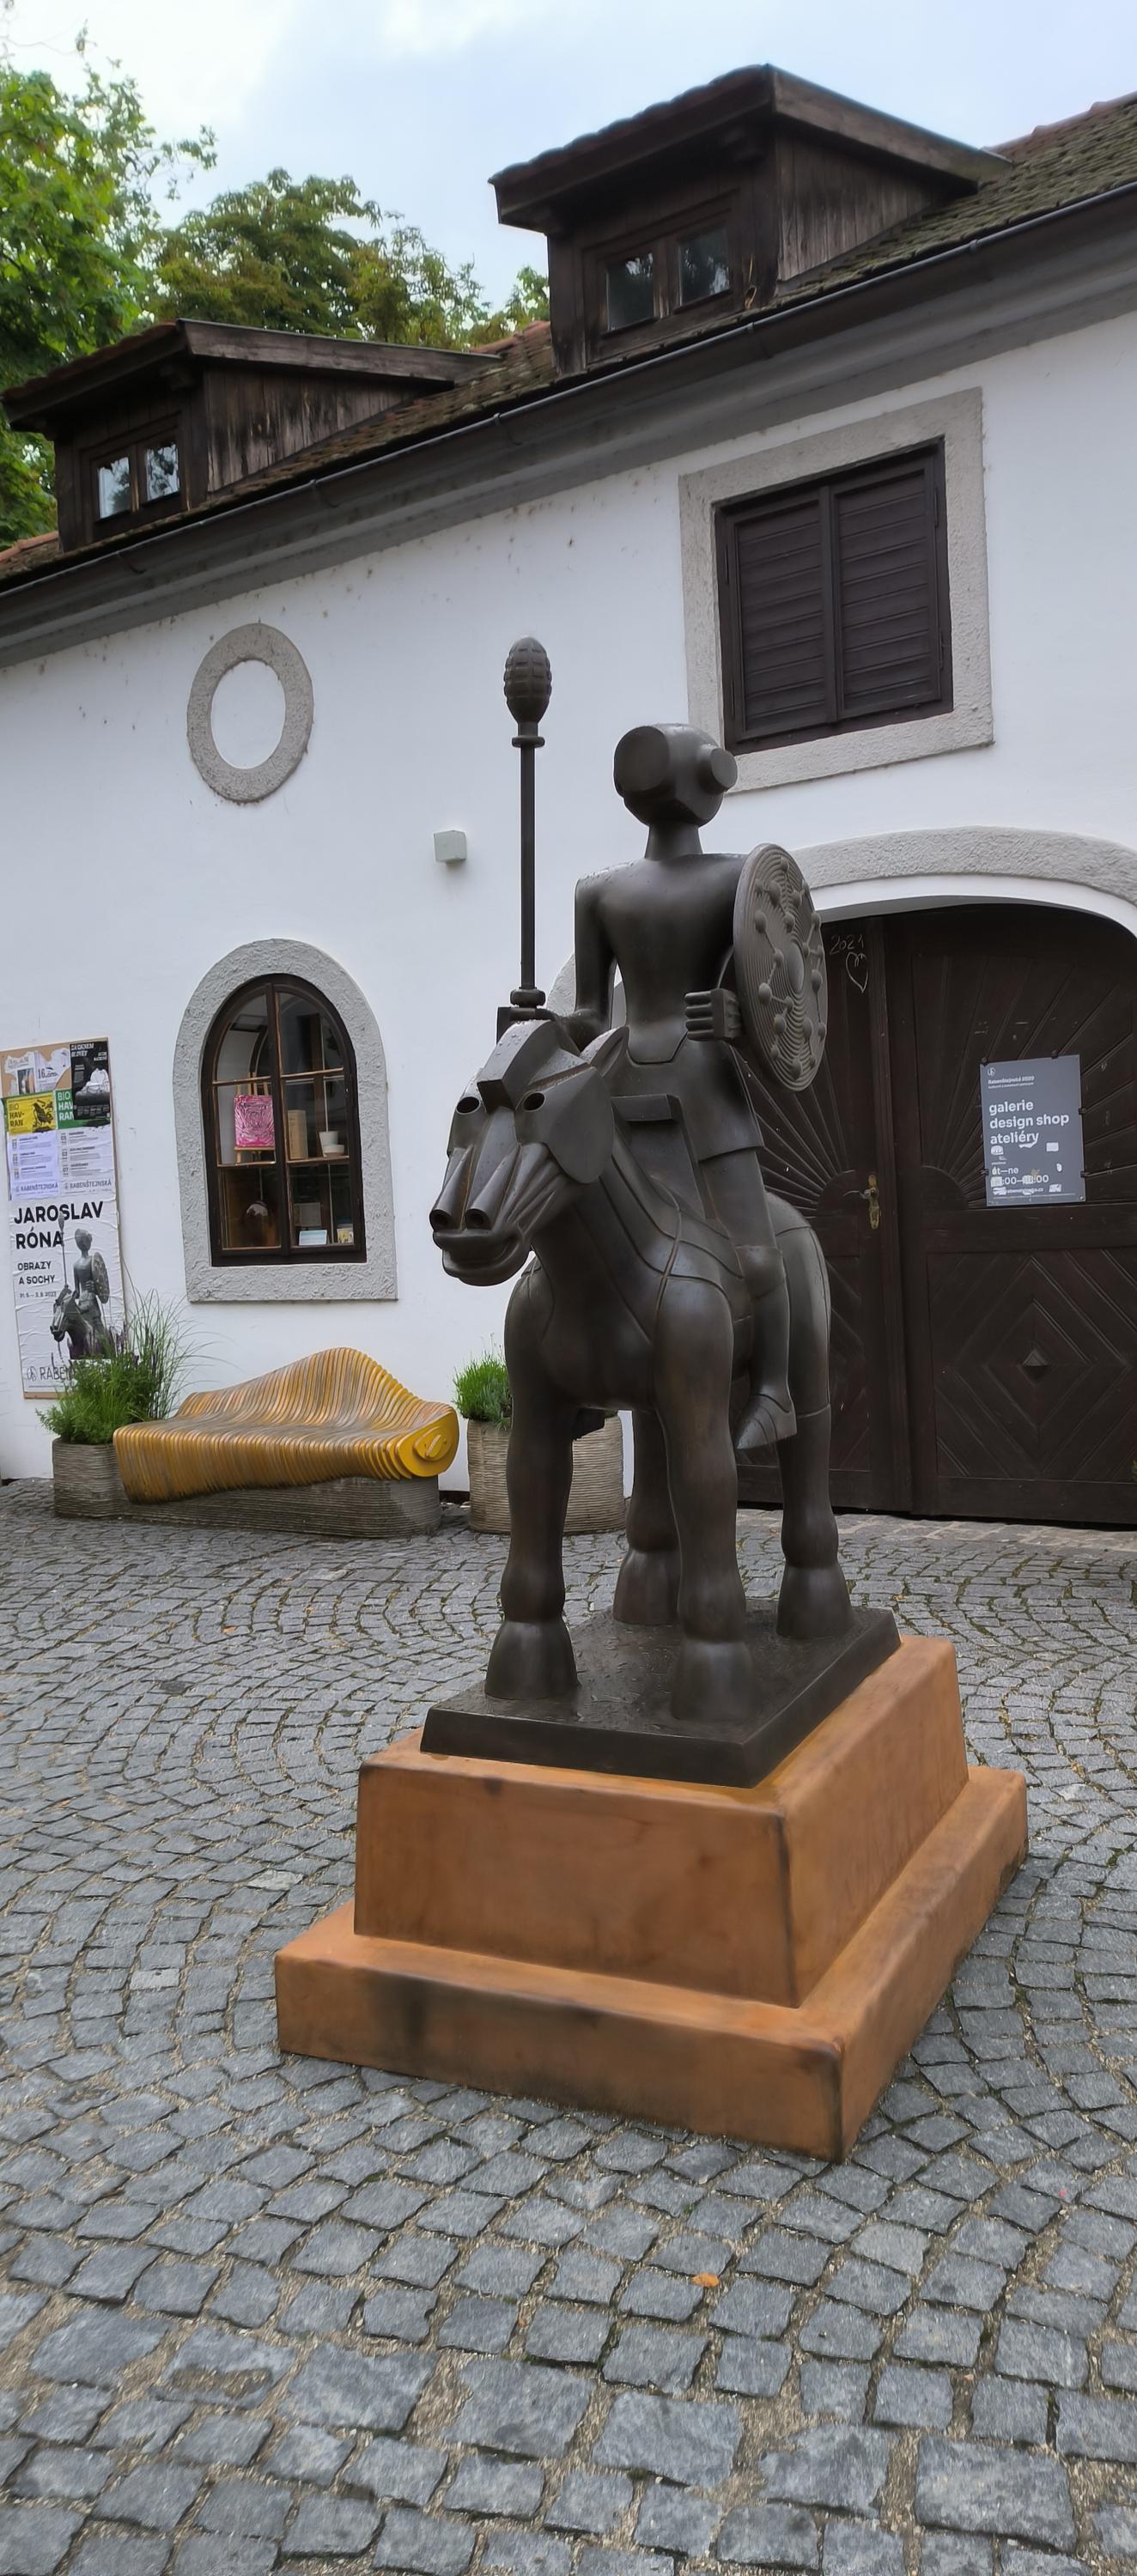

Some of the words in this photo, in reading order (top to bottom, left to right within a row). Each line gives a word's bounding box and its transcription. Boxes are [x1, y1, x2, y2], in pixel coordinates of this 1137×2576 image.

[830, 934, 864, 955] 2021
[58, 1091, 71, 1102] BIO
[8, 1103, 20, 1112] BIO
[988, 1099, 1034, 1116] galerie
[9, 1111, 25, 1120] HAV-
[10, 1119, 23, 1127] RAN
[989, 1115, 1034, 1130] design
[1036, 1114, 1070, 1127] shop
[990, 1130, 1039, 1145] ateliéry
[70, 1179, 112, 1189] RABENŠTEJNSKÁ
[14, 1200, 104, 1224] JAROSLAV
[15, 1226, 64, 1249] RÓNA
[17, 1261, 52, 1272] OBRAZY
[19, 1277, 25, 1285] A
[27, 1275, 55, 1285] SOCHY
